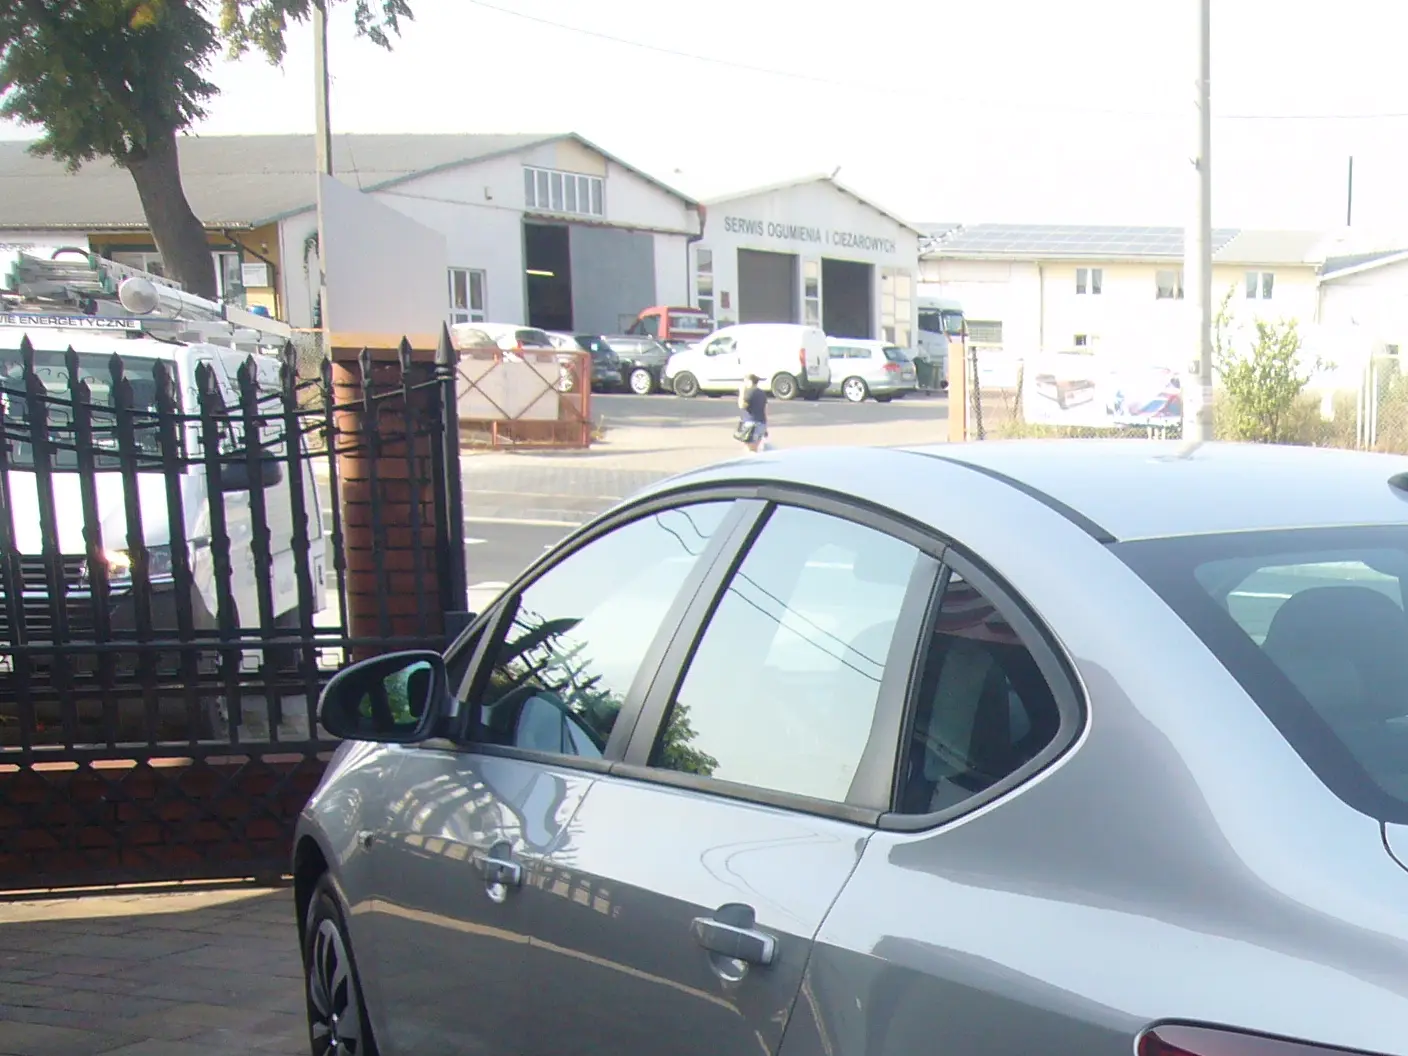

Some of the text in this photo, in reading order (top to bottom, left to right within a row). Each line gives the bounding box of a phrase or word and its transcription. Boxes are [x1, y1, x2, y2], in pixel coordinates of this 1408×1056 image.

[724, 216, 764, 236] SERWIS
[767, 222, 822, 244] OGUMIENIA
[19, 315, 137, 329] ENERGETYCZNE
